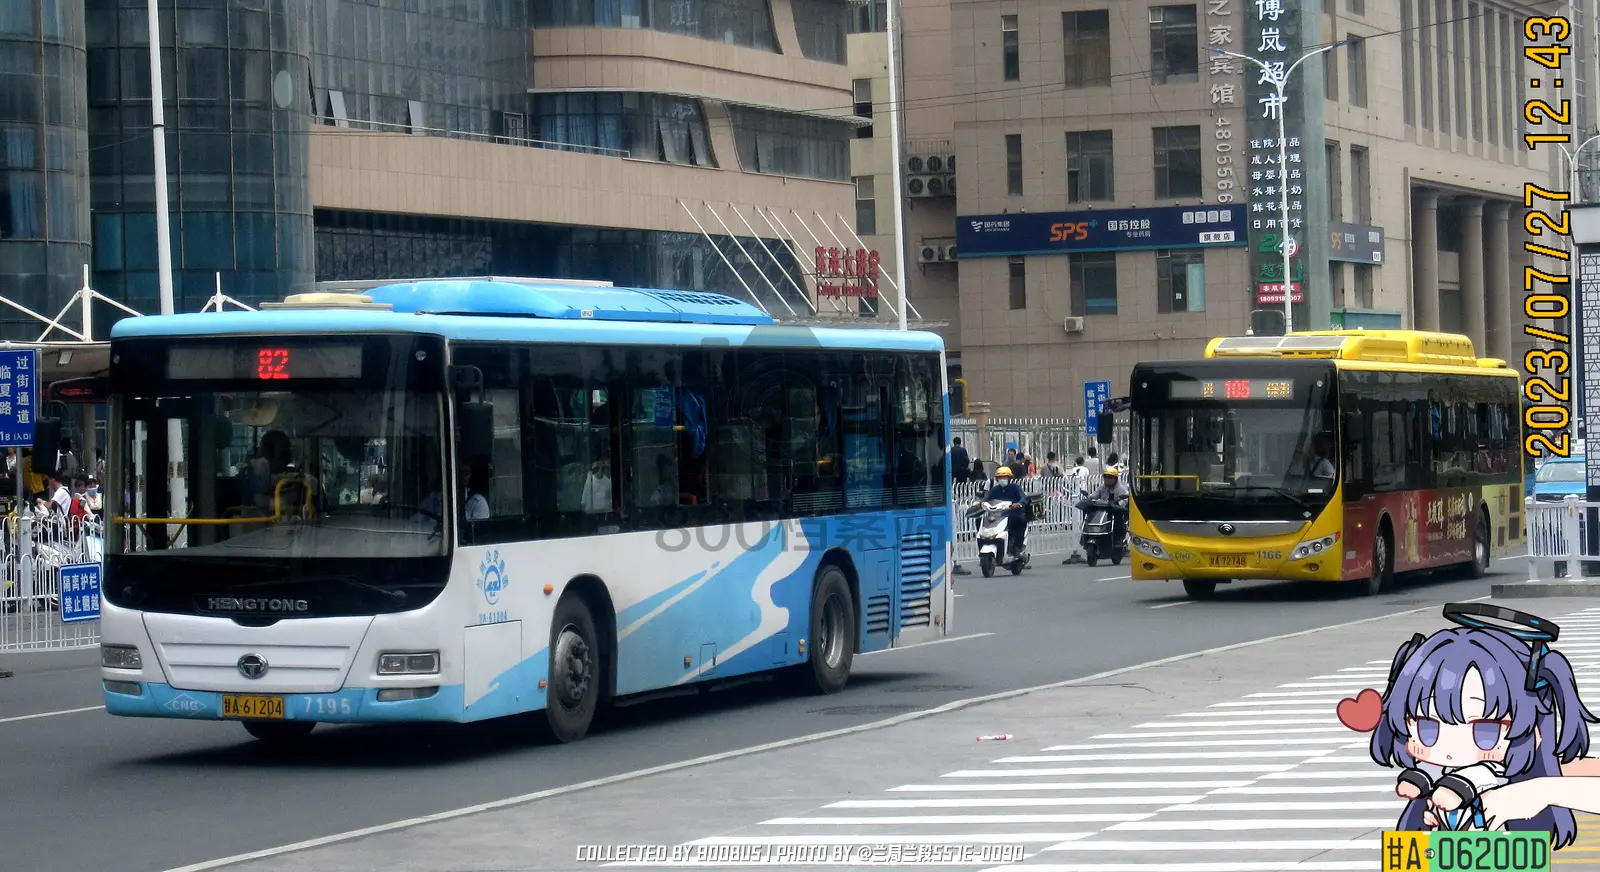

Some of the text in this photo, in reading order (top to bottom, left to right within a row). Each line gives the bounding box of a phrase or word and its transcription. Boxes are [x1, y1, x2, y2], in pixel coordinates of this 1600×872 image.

[1255, 0, 1289, 120] 博岚超市
[1215, 117, 1234, 203] 4805566
[1107, 219, 1151, 231] 国药控股
[257, 348, 290, 379] 82
[0, 365, 12, 416] 临夏路
[16, 355, 30, 424] 过街通道
[1224, 379, 1251, 399] 105
[63, 572, 98, 592] 隔离护栏
[207, 597, 308, 612] HENGTONG
[171, 700, 199, 711] CNG
[304, 696, 351, 714] 7195
